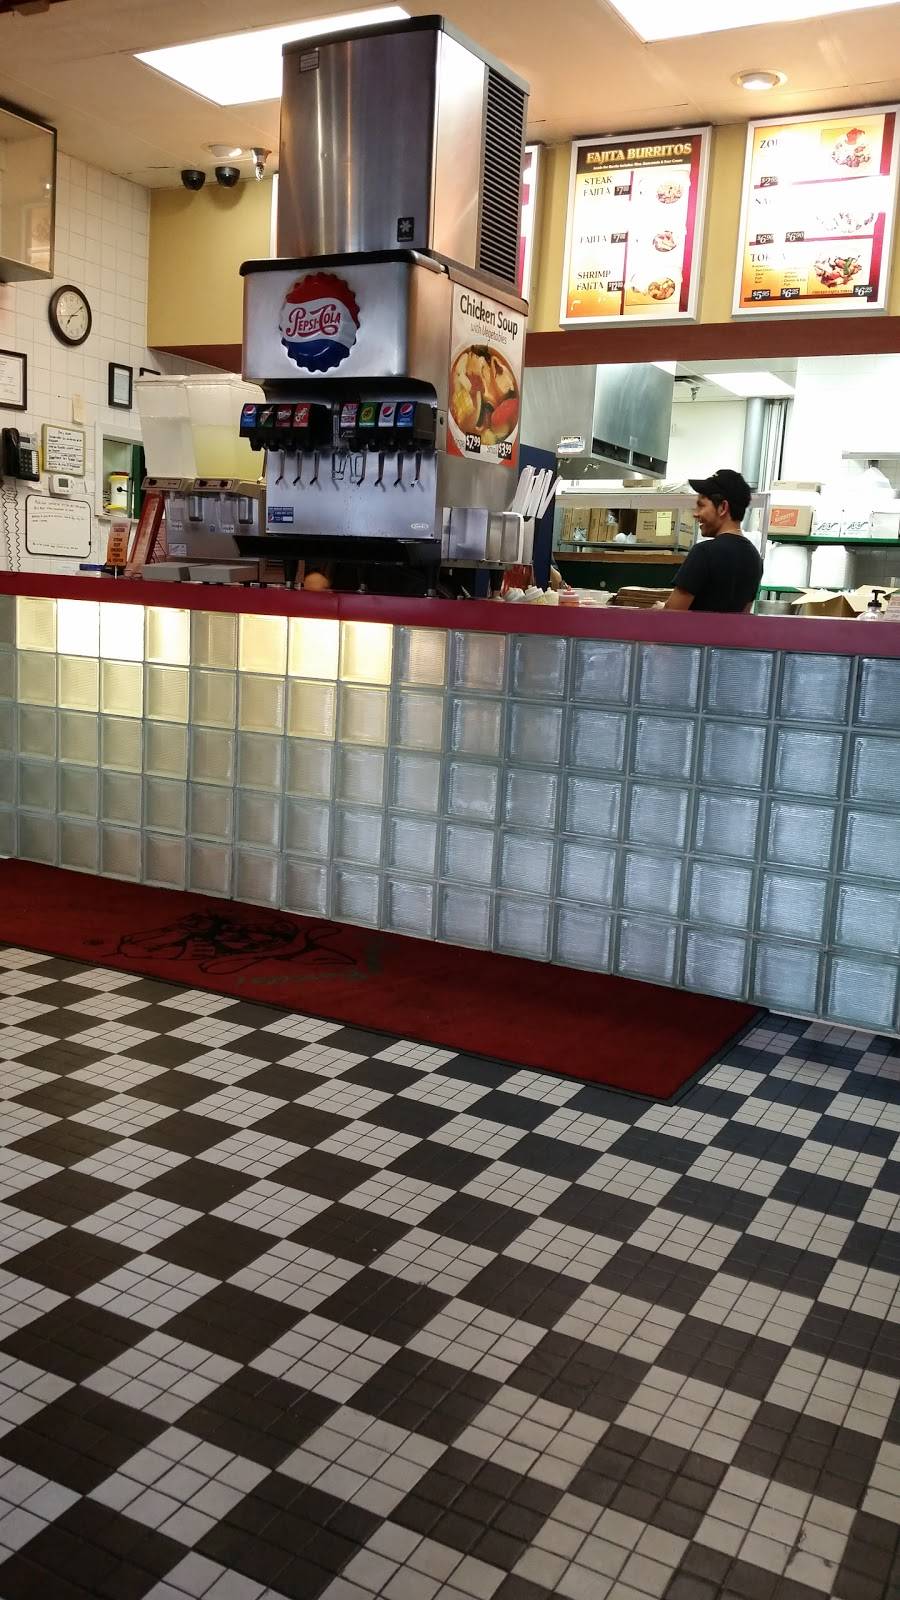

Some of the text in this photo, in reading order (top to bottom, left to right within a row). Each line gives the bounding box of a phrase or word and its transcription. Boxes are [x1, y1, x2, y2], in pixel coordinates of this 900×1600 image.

[586, 143, 692, 164] FAJITA BURRITOS
[584, 175, 613, 186] STEAK
[583, 187, 611, 197] FAJITA
[576, 270, 612, 280] SHRIMP
[576, 281, 604, 291] FAJITA
[460, 294, 518, 340] Chicken Soup
